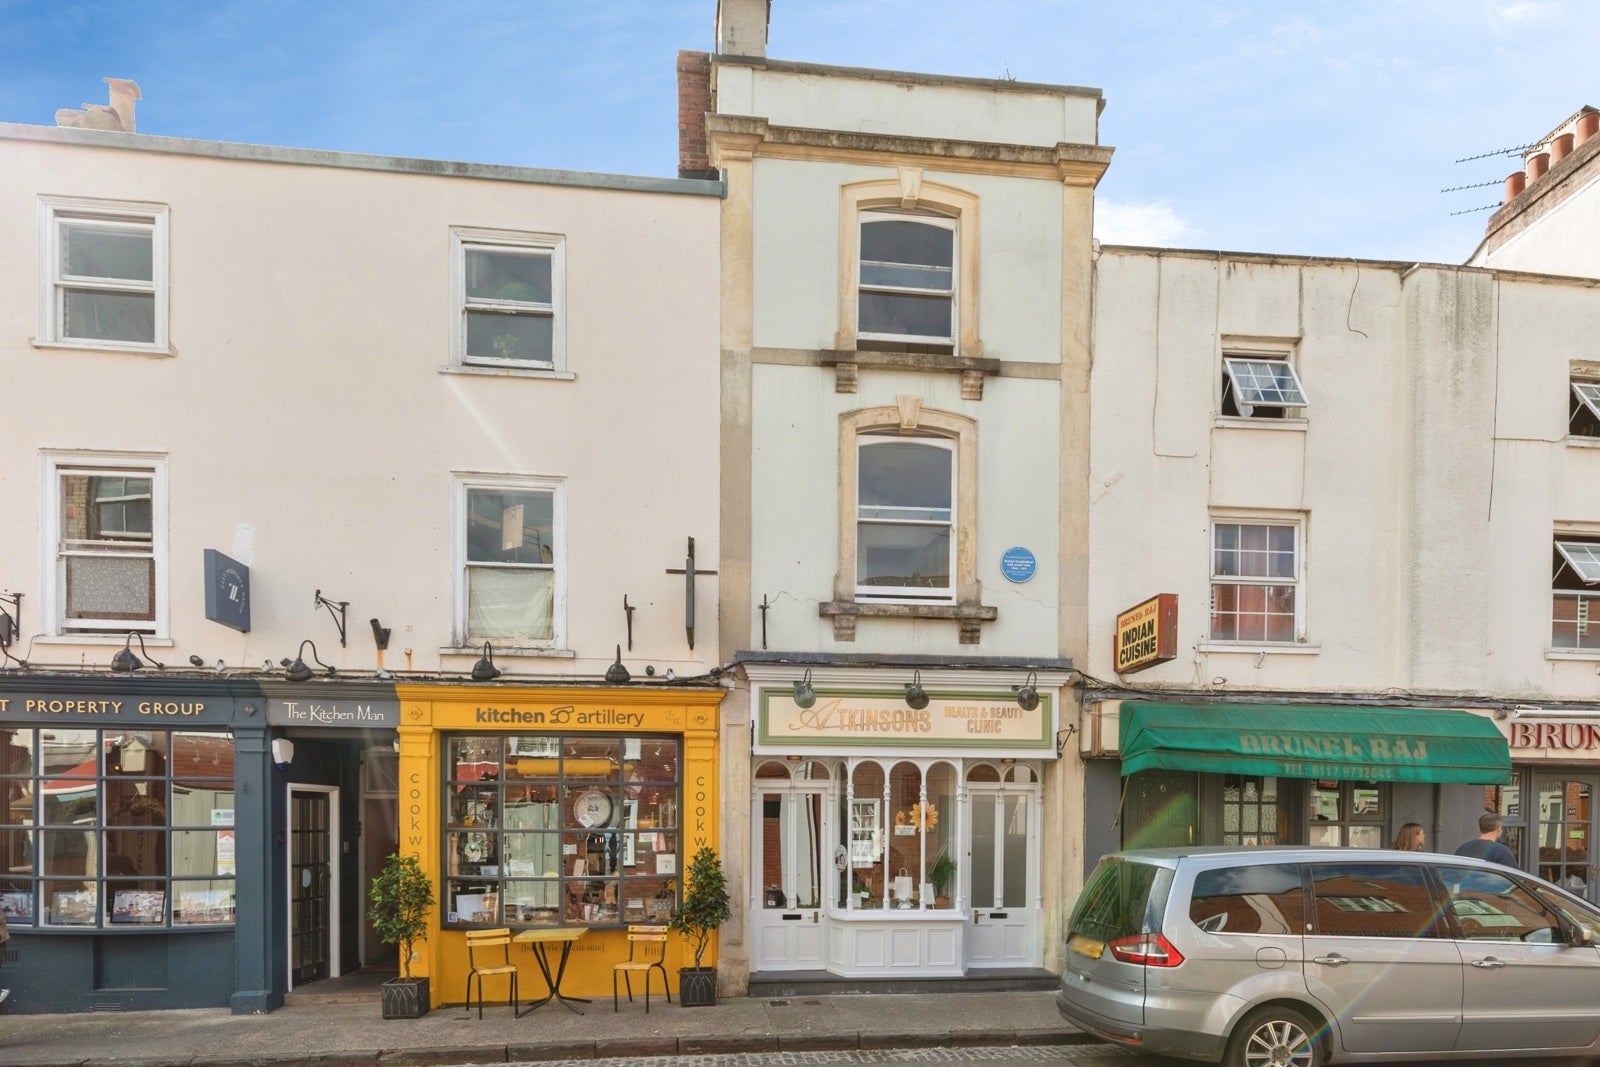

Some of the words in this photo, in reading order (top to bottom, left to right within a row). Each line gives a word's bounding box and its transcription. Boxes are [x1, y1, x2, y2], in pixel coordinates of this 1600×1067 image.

[1122, 618, 1155, 648] INDIAN
[1119, 635, 1157, 665] CUISINE
[25, 700, 123, 714] PROPERTY
[138, 702, 205, 716] GROUP
[283, 702, 307, 719] The
[310, 704, 354, 723] Kitchen
[357, 705, 384, 720] Man
[476, 708, 545, 723] kitchen
[577, 709, 645, 727] artillery
[944, 706, 978, 718] HEALTH
[980, 706, 988, 718] &
[989, 707, 1024, 719] BEAUTY
[967, 719, 1002, 733] CLINIC
[1369, 737, 1428, 760] RAJ
[1159, 784, 1167, 793] 6
